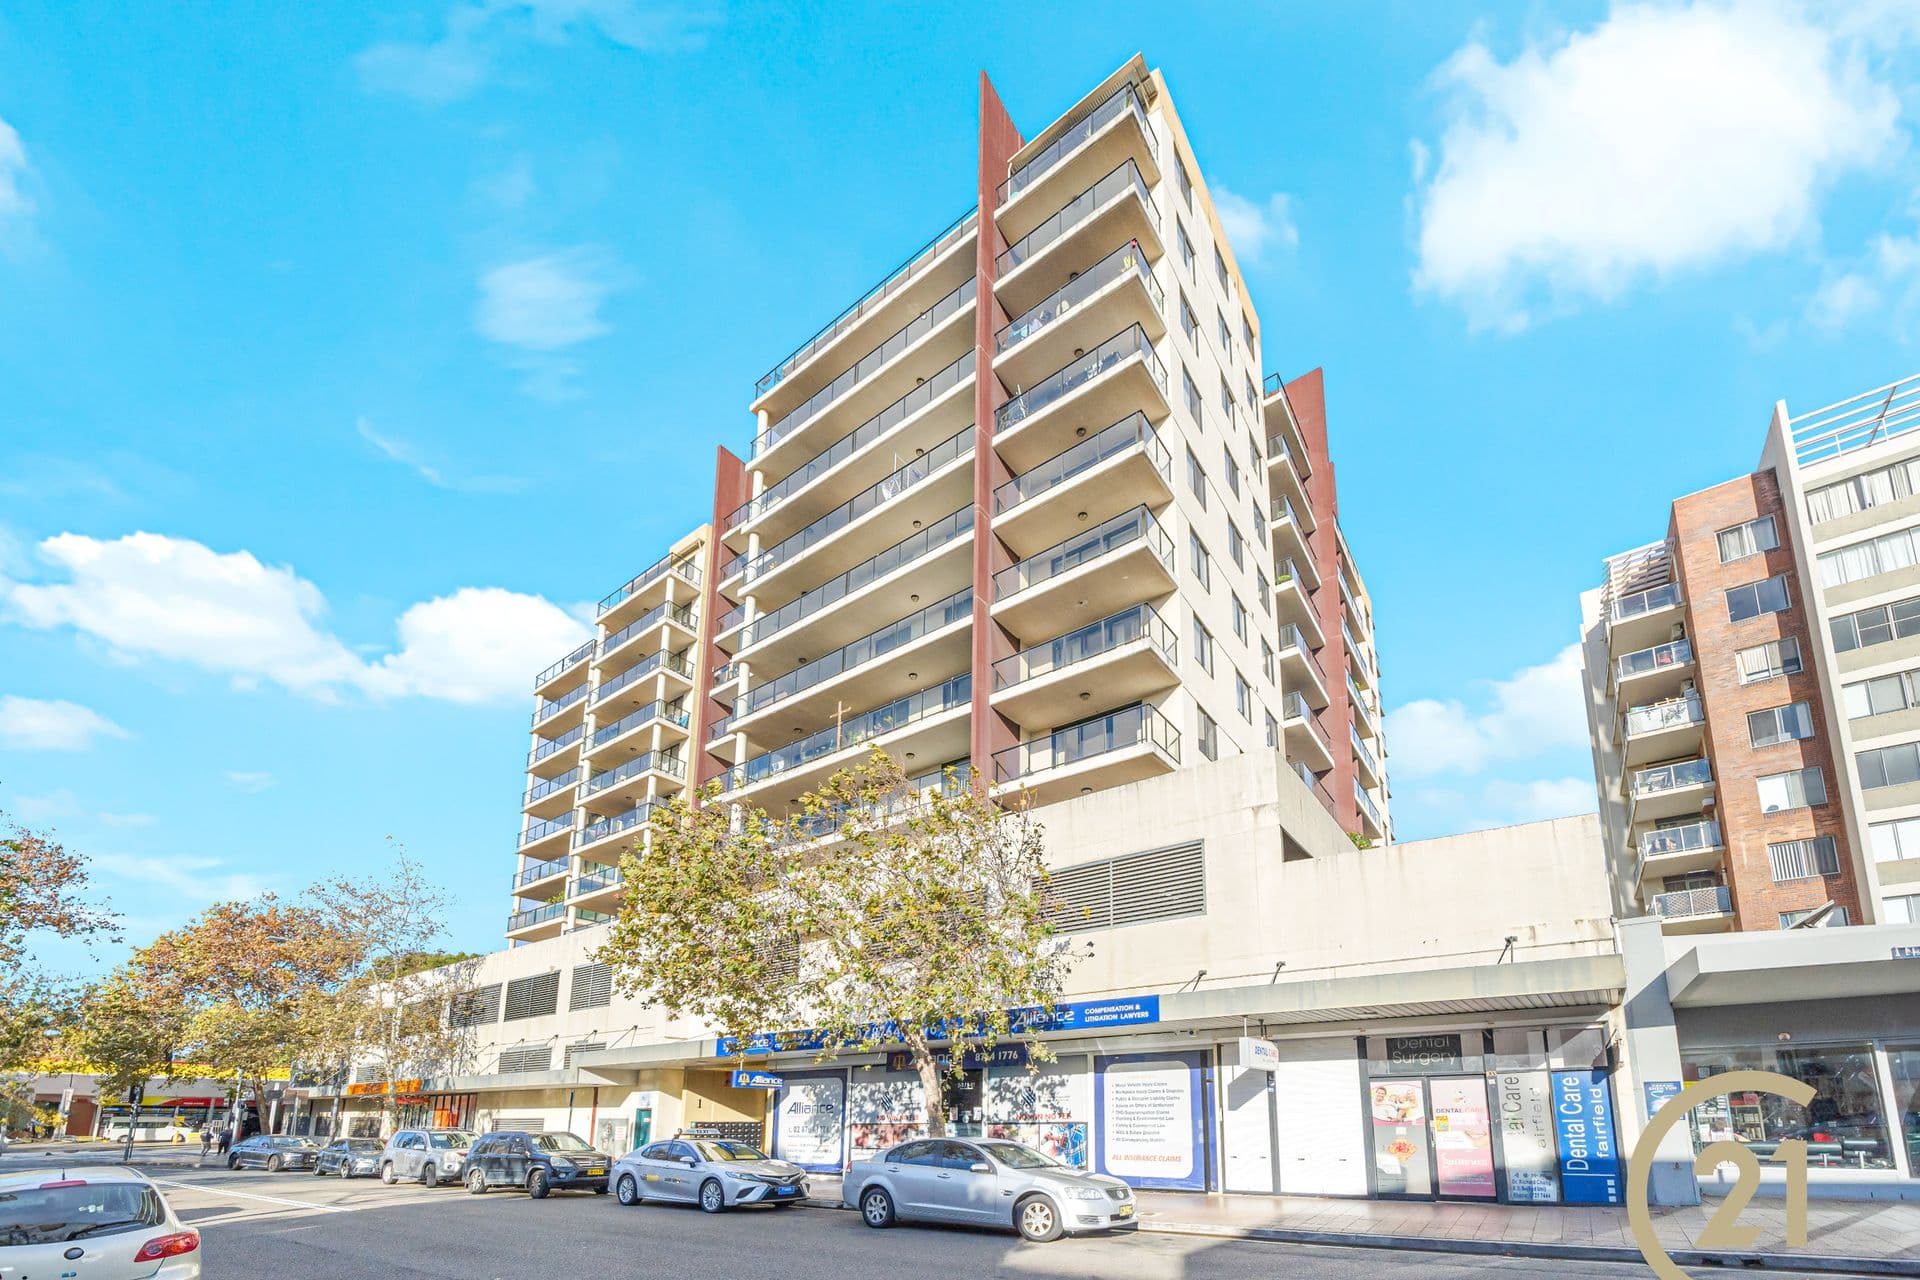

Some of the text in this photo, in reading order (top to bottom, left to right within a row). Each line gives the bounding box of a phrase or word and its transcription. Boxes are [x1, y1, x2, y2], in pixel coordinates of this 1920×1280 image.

[1085, 1005, 1133, 1015] COMPENSATION
[1085, 1011, 1149, 1022] LITIGATION LAWYERS
[1012, 1009, 1075, 1029] Alliance
[1397, 1035, 1450, 1050] Dental
[998, 1050, 1019, 1060] 1776
[750, 1075, 783, 1086] Alliance
[1502, 1076, 1521, 1113] Care
[787, 1101, 834, 1115] Alliance
[1560, 1076, 1589, 1171] Dental Care
[1590, 1087, 1610, 1158] fairfield
